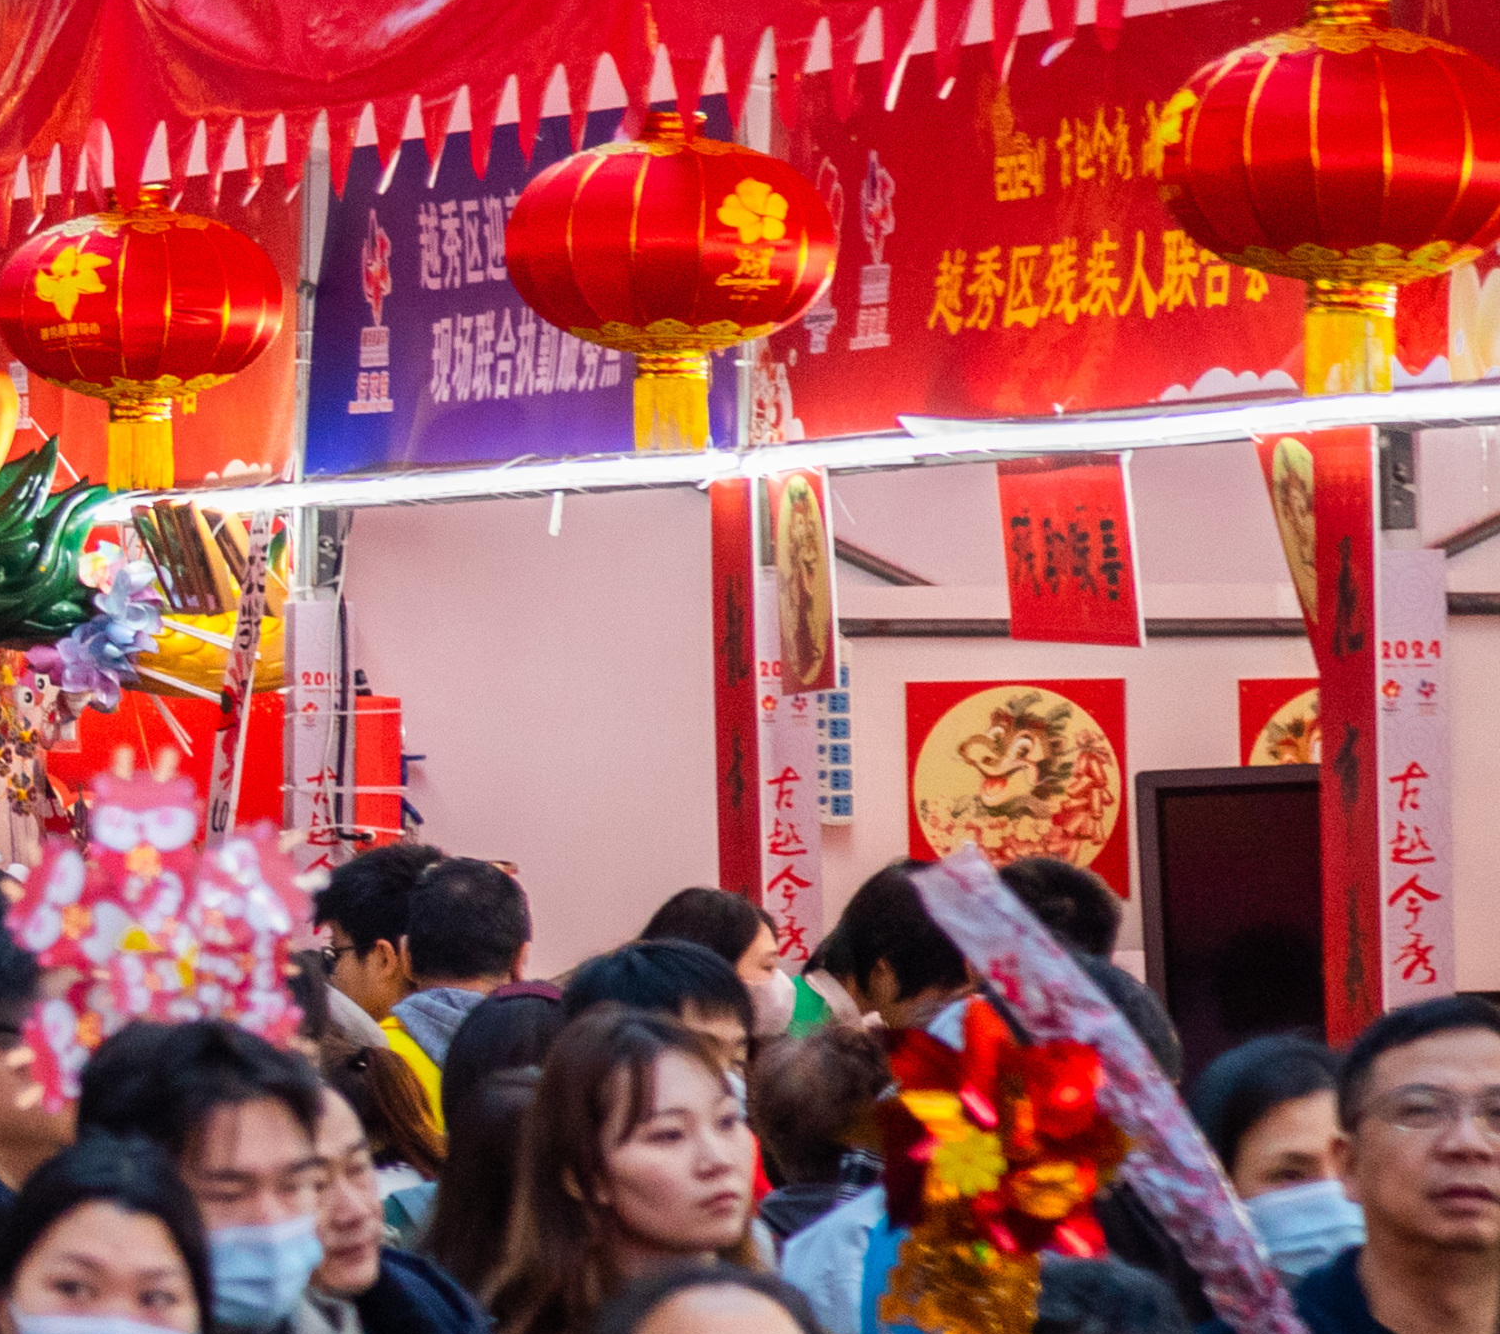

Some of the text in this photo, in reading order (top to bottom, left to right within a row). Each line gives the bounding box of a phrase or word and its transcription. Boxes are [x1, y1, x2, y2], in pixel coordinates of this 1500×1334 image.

[418, 188, 522, 290] 越秀区迎
[1380, 639, 1442, 660] 2024
[766, 765, 813, 962] 古越今秀
[1387, 760, 1443, 985] 古越今秀
